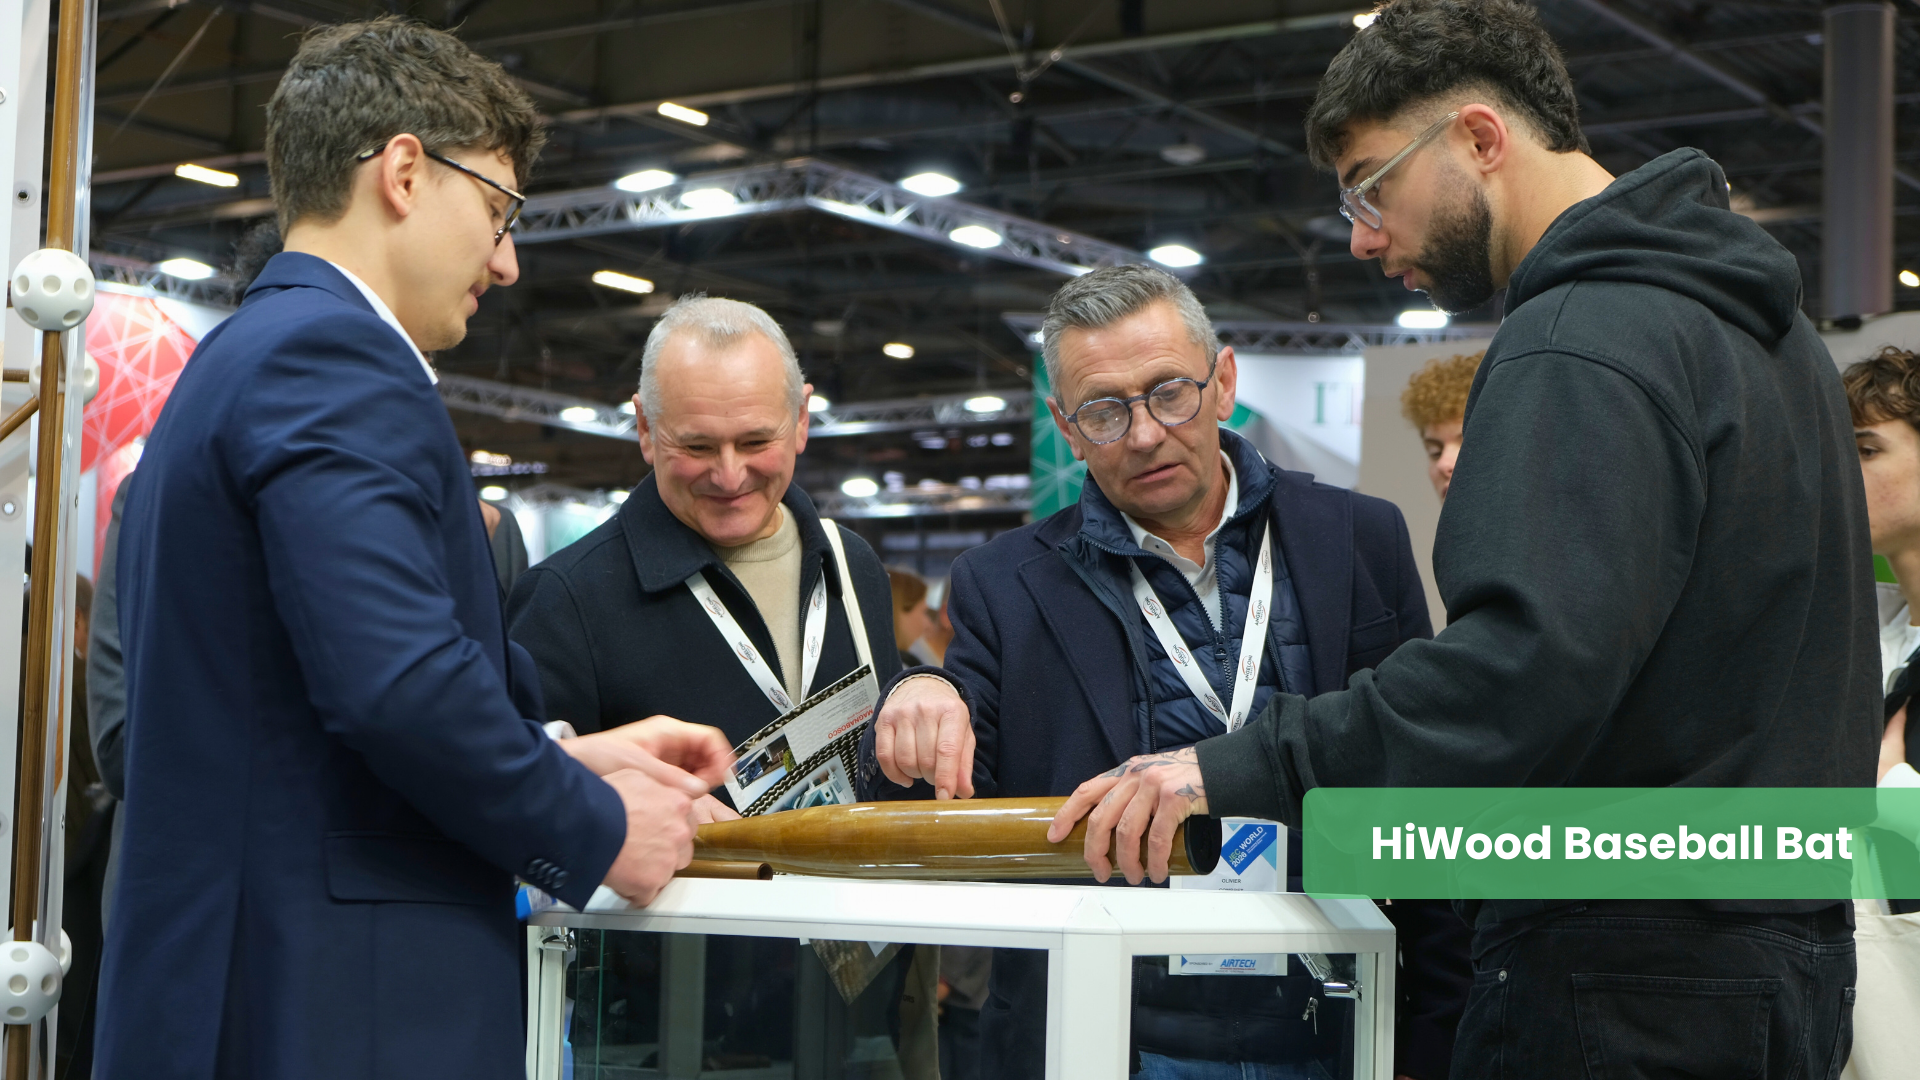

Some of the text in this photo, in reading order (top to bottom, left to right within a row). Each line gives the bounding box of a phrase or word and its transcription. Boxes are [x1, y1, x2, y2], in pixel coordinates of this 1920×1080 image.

[1145, 596, 1161, 619] ANGELONI
[1254, 600, 1263, 626] ANGELONI
[1173, 644, 1188, 667] ANGELONI
[1244, 655, 1253, 682] ANGELONI
[828, 709, 874, 739] MAGNABOSCO
[1228, 848, 1241, 863] JEC
[1239, 826, 1264, 850] WORLD
[1231, 851, 1248, 868] 2026
[1220, 958, 1256, 968] AIRTECH
